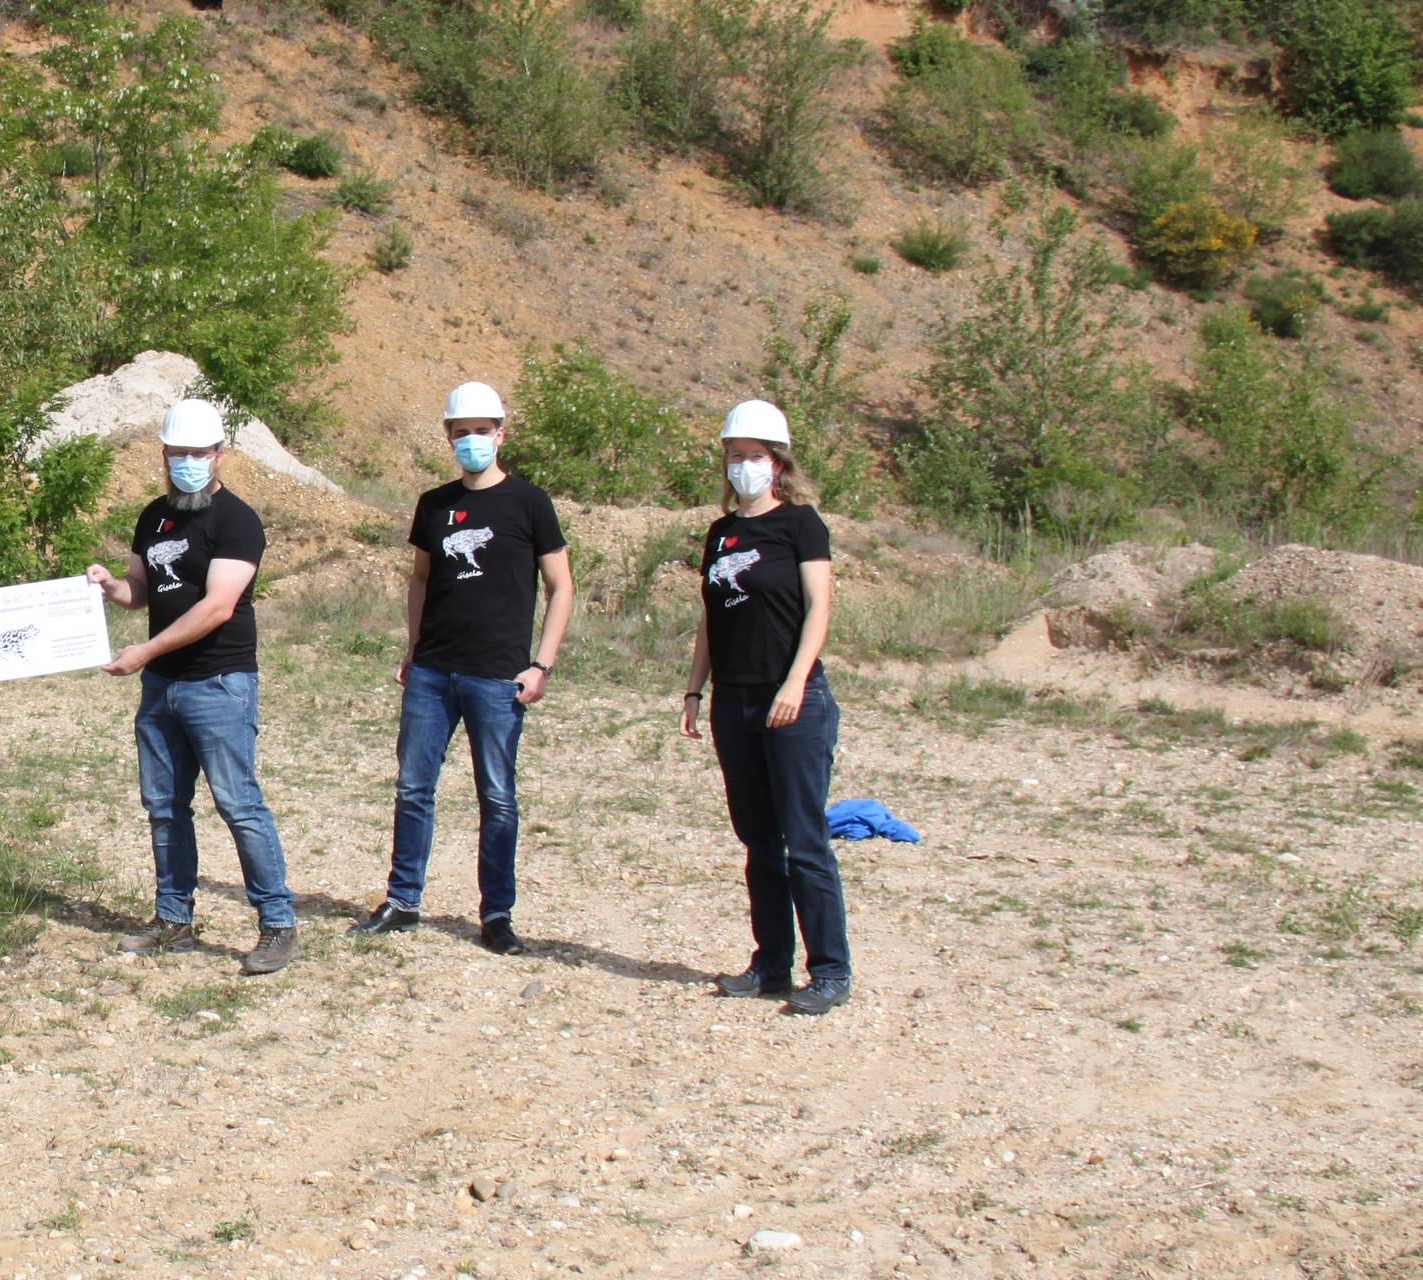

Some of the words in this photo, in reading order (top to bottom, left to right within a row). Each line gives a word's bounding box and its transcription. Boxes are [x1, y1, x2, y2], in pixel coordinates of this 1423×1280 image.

[156, 518, 166, 532] I
[447, 510, 456, 526] I
[717, 536, 726, 552] I
[157, 582, 183, 593] Gisela
[724, 594, 750, 608] Gisela
